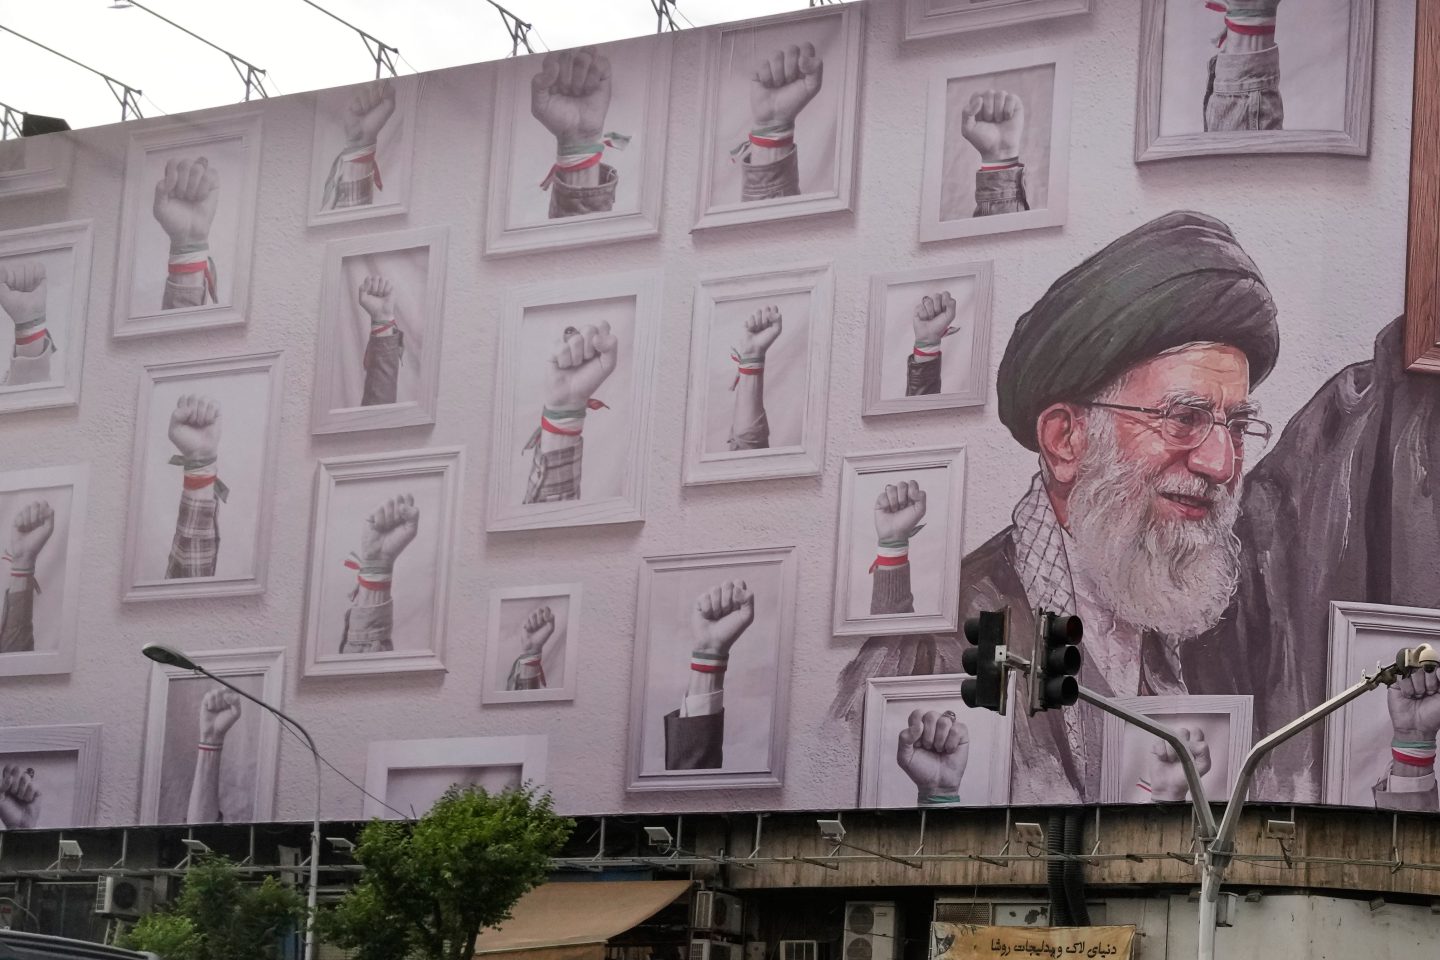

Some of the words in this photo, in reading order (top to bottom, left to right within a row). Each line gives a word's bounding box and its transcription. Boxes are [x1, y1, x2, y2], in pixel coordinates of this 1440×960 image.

[990, 938, 1011, 958] روشا
[1056, 946, 1063, 959] و
[1065, 940, 1085, 955] لاک
[1086, 940, 1118, 959] دنیای
